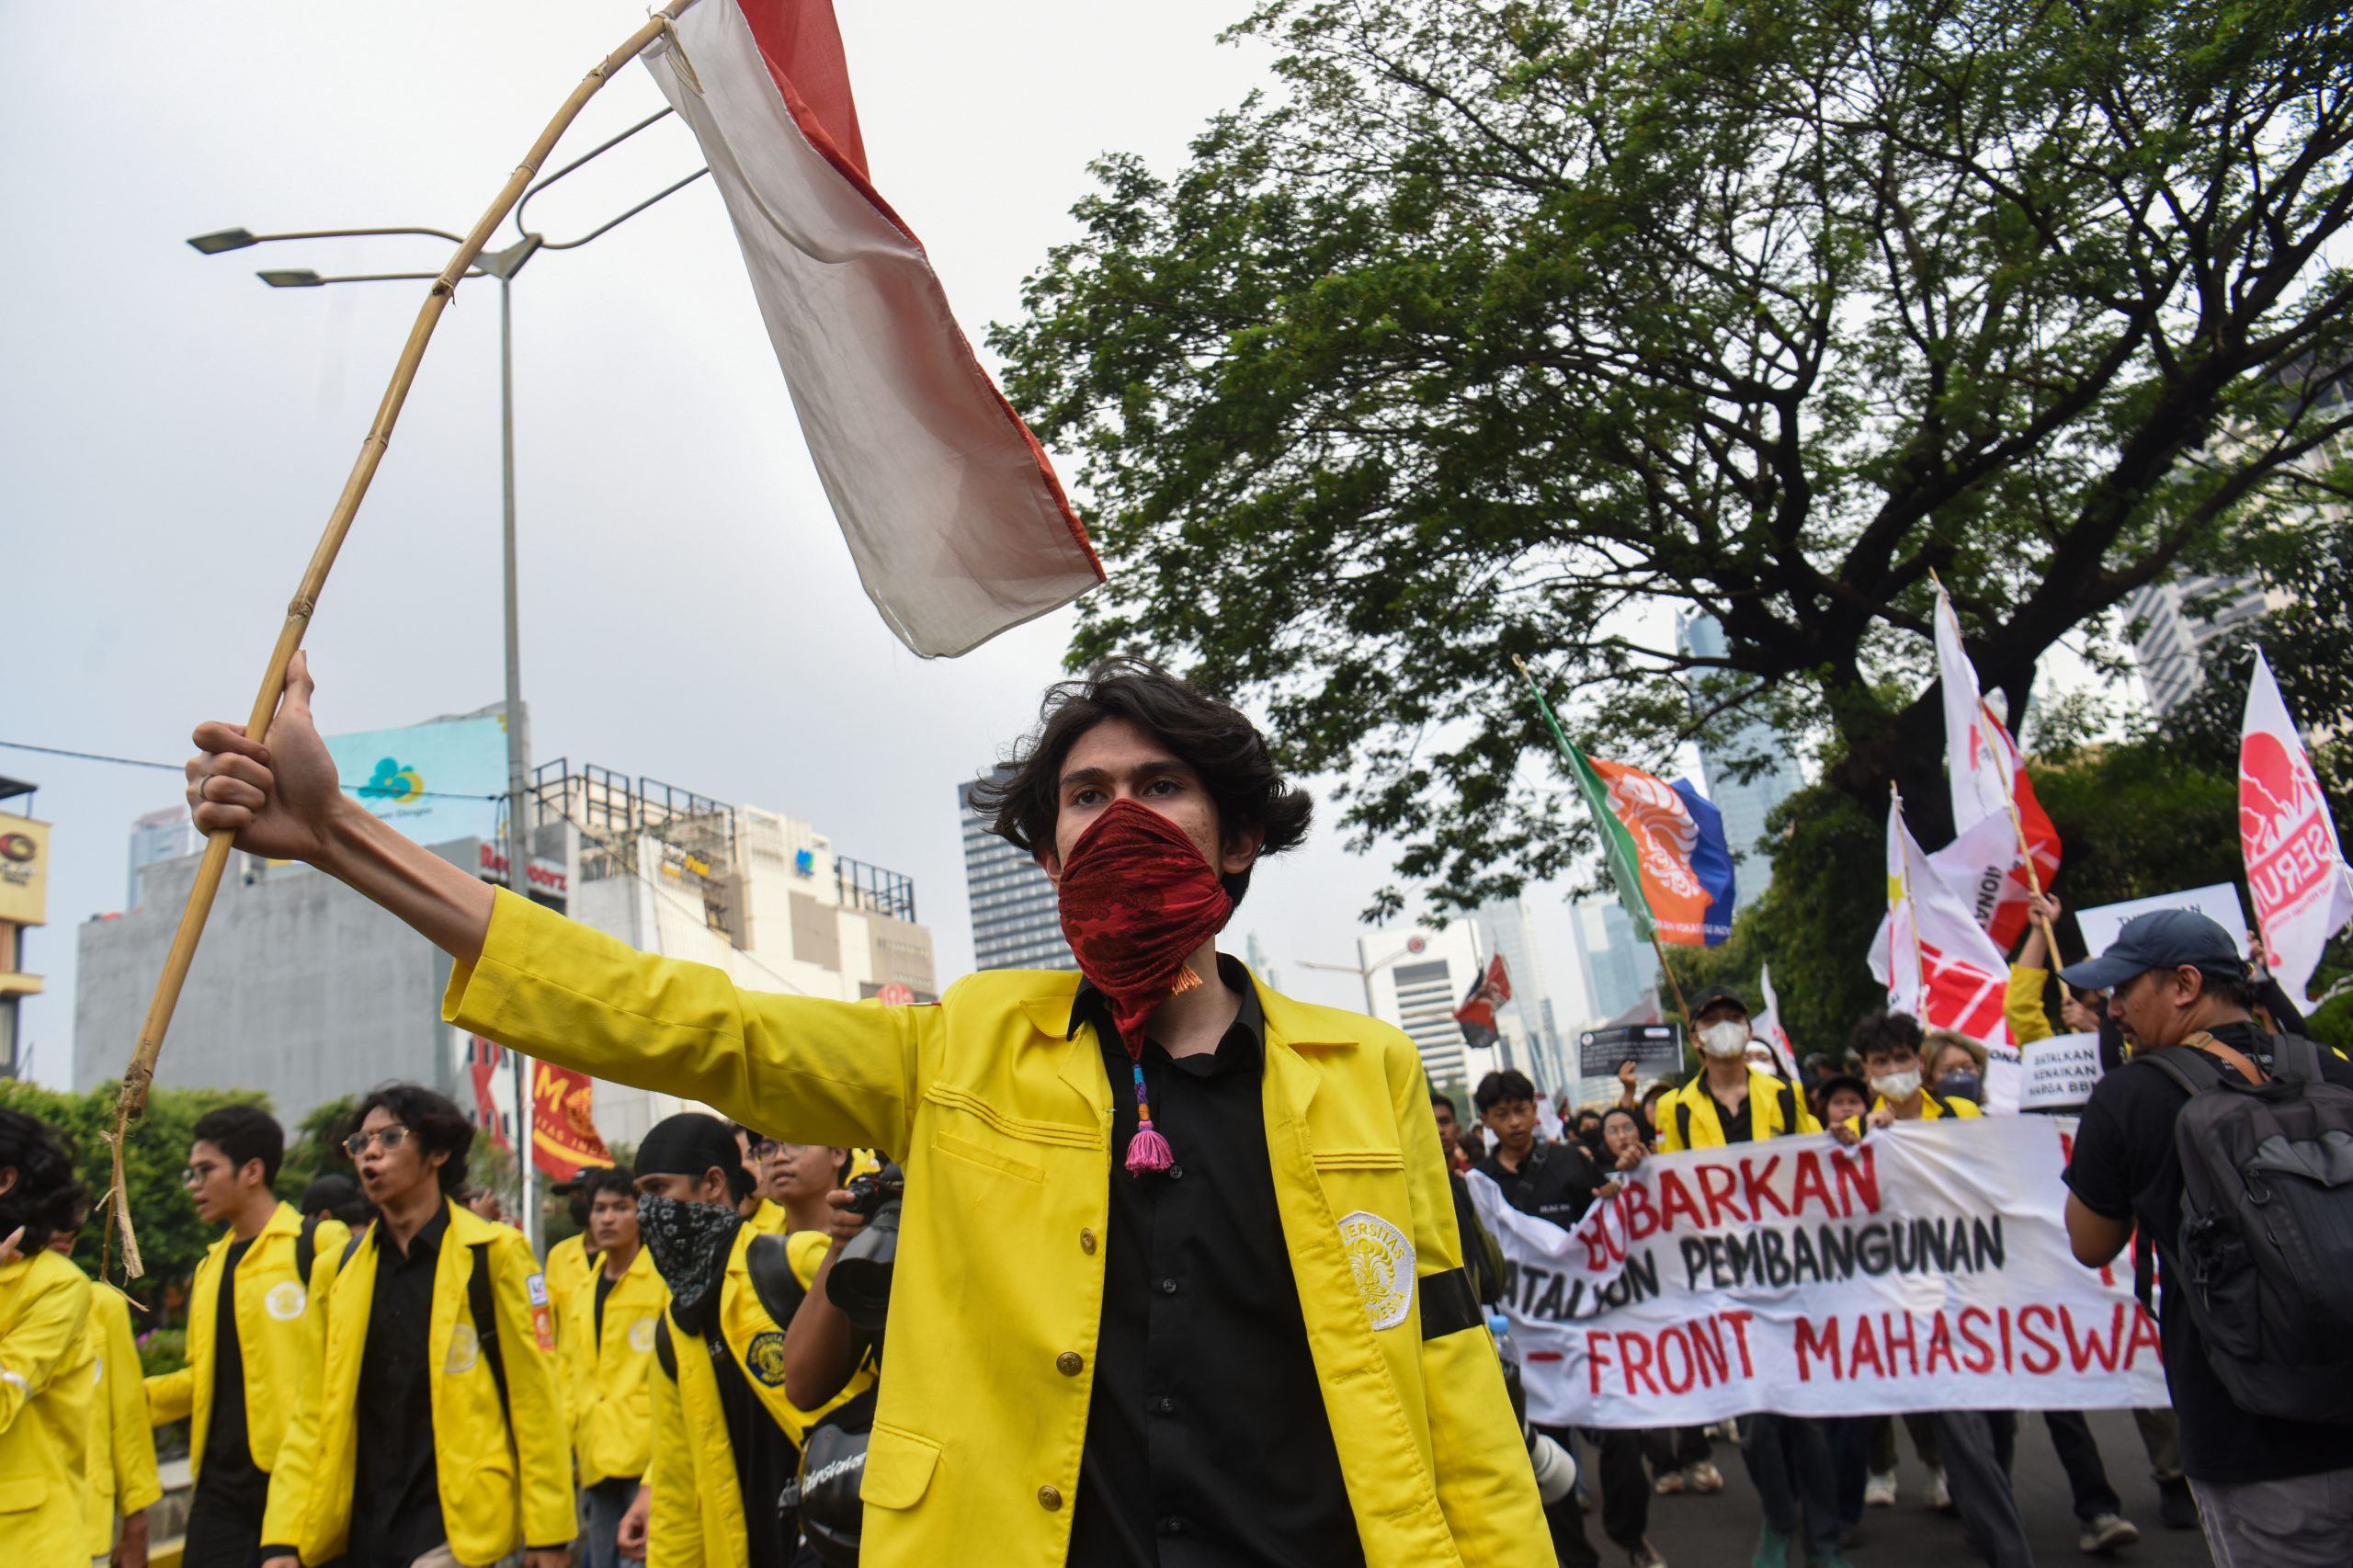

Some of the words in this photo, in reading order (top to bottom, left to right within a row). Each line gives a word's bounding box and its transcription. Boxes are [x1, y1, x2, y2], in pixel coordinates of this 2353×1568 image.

[2034, 1064, 2097, 1081] KENAIKAN
[1343, 1221, 1405, 1260] VERSITAS
[1680, 1214, 2005, 1291] PEMBANGUNAN
[1369, 1290, 1405, 1322] NESIA
[1587, 1311, 1754, 1396] FRONT
[1794, 1303, 2162, 1382] MAHASISWA
